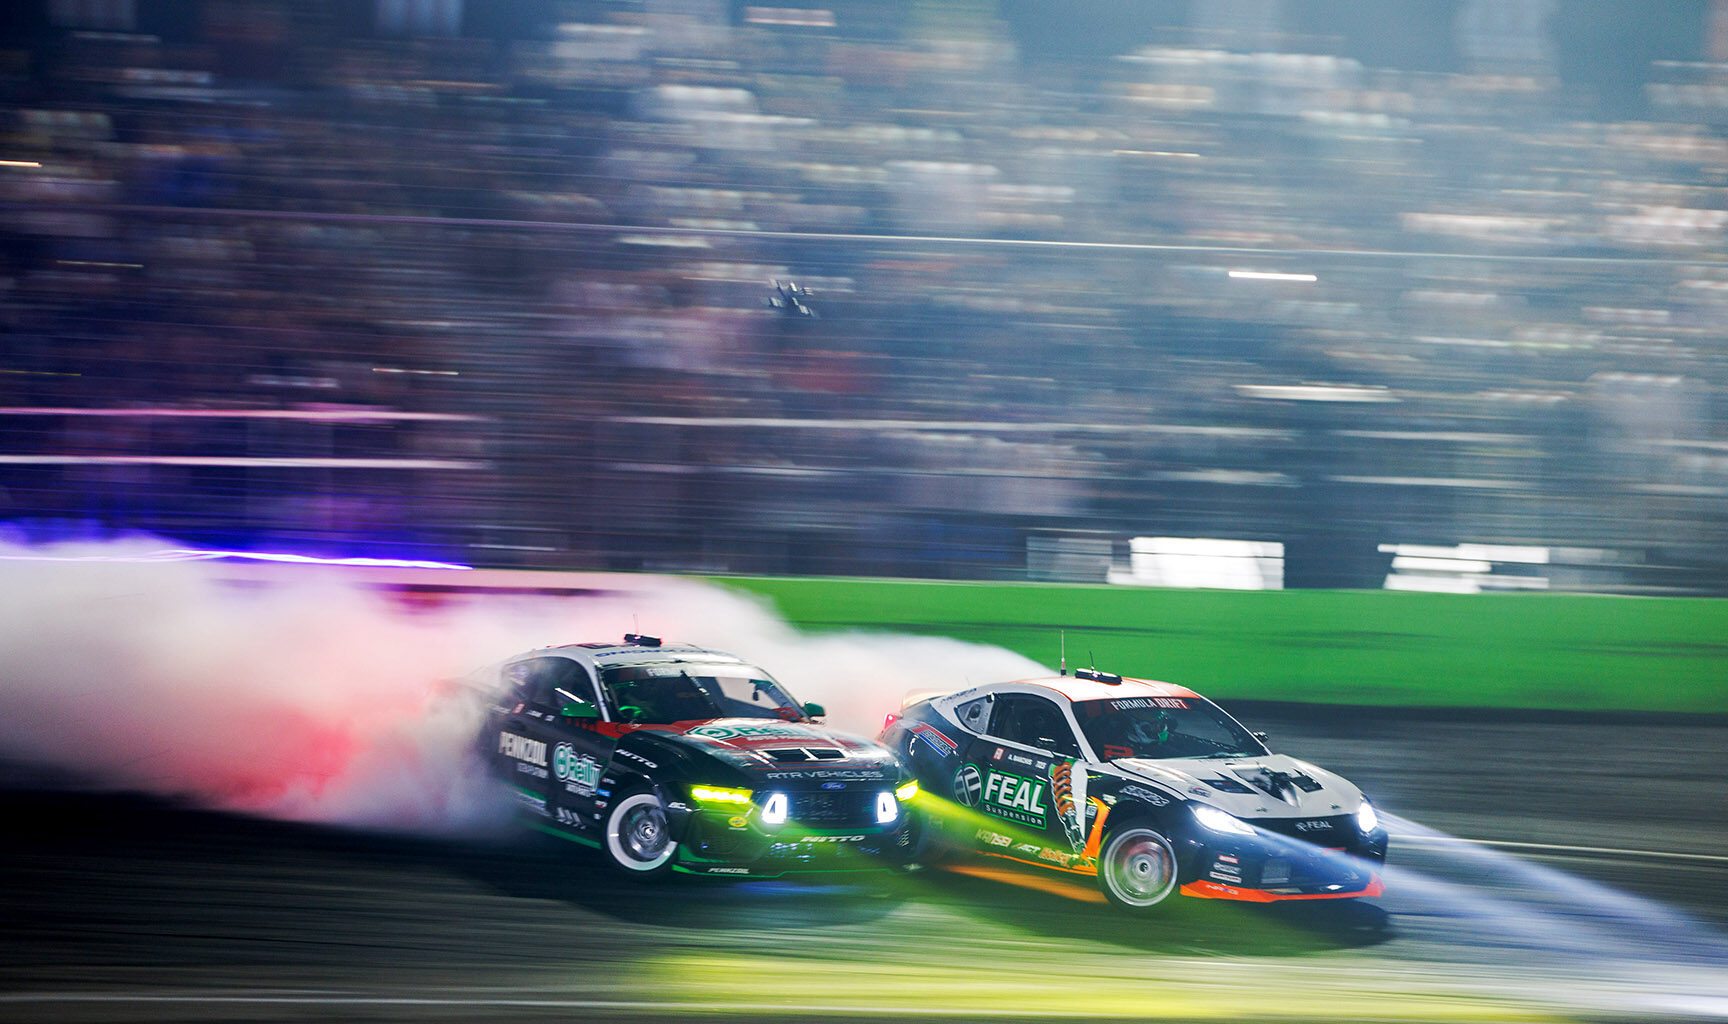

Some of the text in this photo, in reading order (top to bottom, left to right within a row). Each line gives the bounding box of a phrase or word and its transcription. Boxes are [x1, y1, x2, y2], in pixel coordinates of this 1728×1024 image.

[1110, 697, 1188, 711] FORMULA DRIFT
[499, 731, 548, 767] PENNZOIL
[615, 748, 658, 769] NITTO
[766, 770, 884, 779] RTR VEHICLES
[984, 772, 1045, 815] FEAL
[985, 804, 1043, 826] Suspension
[1307, 820, 1334, 830] FEAL
[800, 834, 866, 843] NITTO
